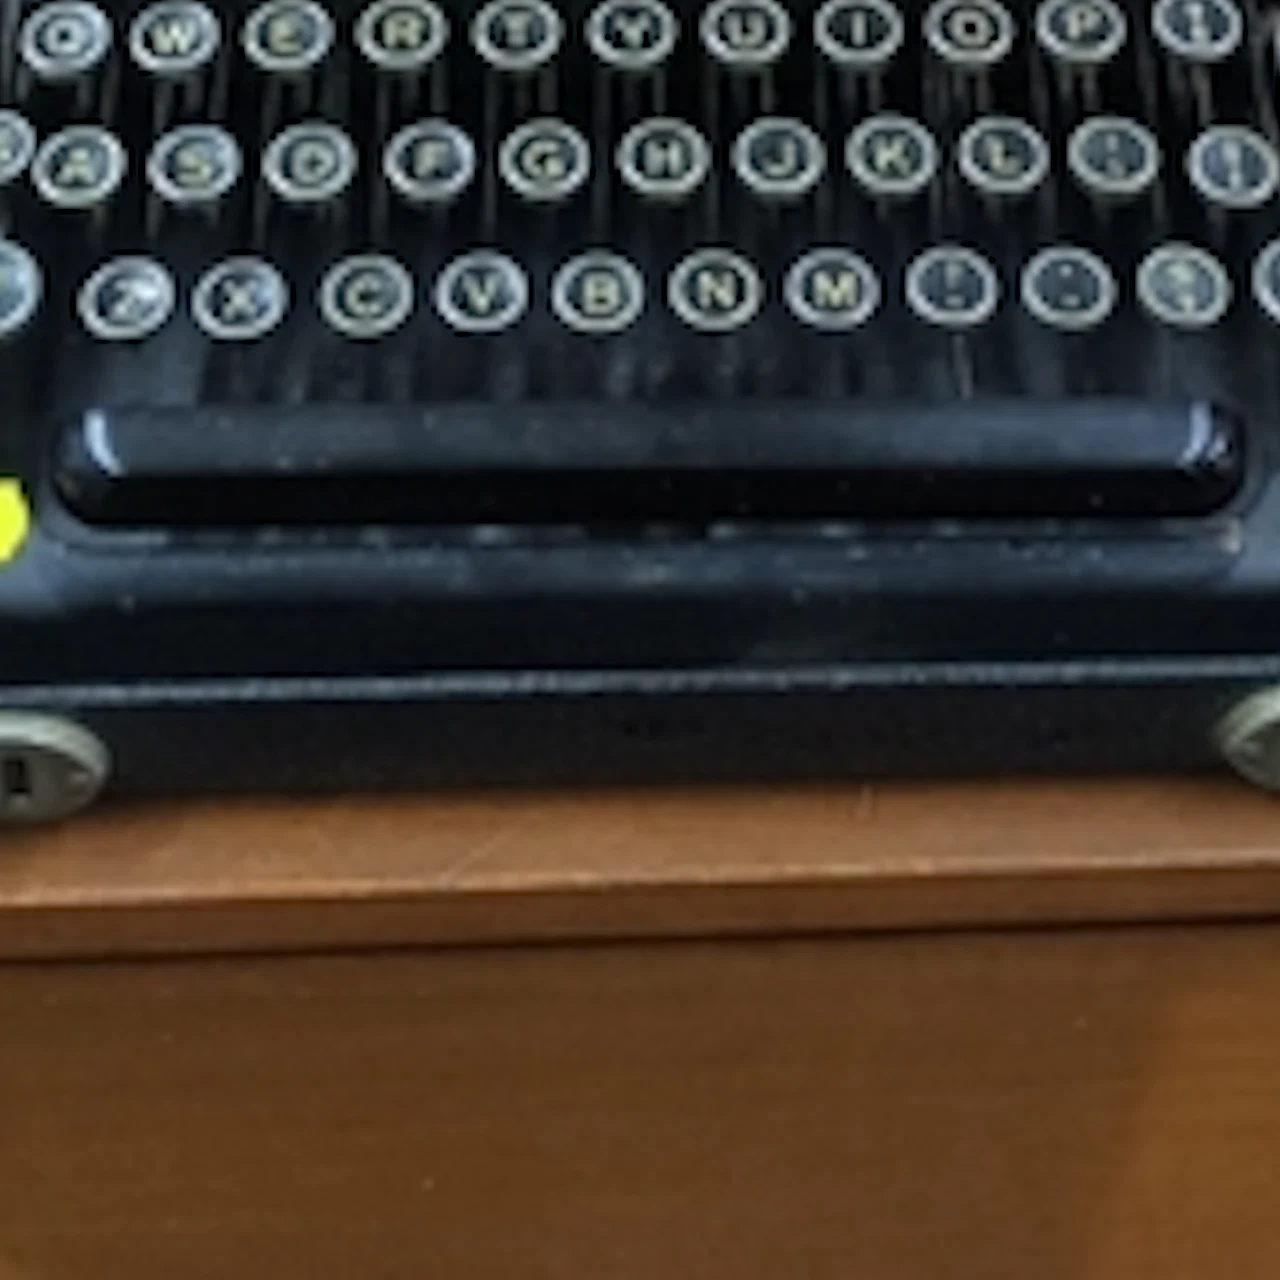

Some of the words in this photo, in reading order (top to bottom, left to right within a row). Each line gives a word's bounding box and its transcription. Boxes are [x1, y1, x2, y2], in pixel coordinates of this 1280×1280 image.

[151, 20, 197, 54] W
[268, 14, 300, 53] E
[384, 16, 424, 49] R
[726, 11, 766, 46] U
[949, 9, 993, 47] O
[1067, 6, 1104, 41] P
[55, 146, 95, 185] A
[175, 144, 210, 187] S
[414, 141, 448, 178] F
[521, 139, 565, 178] G
[644, 139, 682, 177] H
[764, 139, 795, 177] J
[874, 136, 909, 173] K
[984, 134, 1018, 172] L
[221, 278, 260, 319] X
[345, 273, 384, 315] C
[461, 271, 501, 313] V
[582, 275, 619, 315] B
[699, 270, 736, 309] N
[812, 270, 855, 308] M
